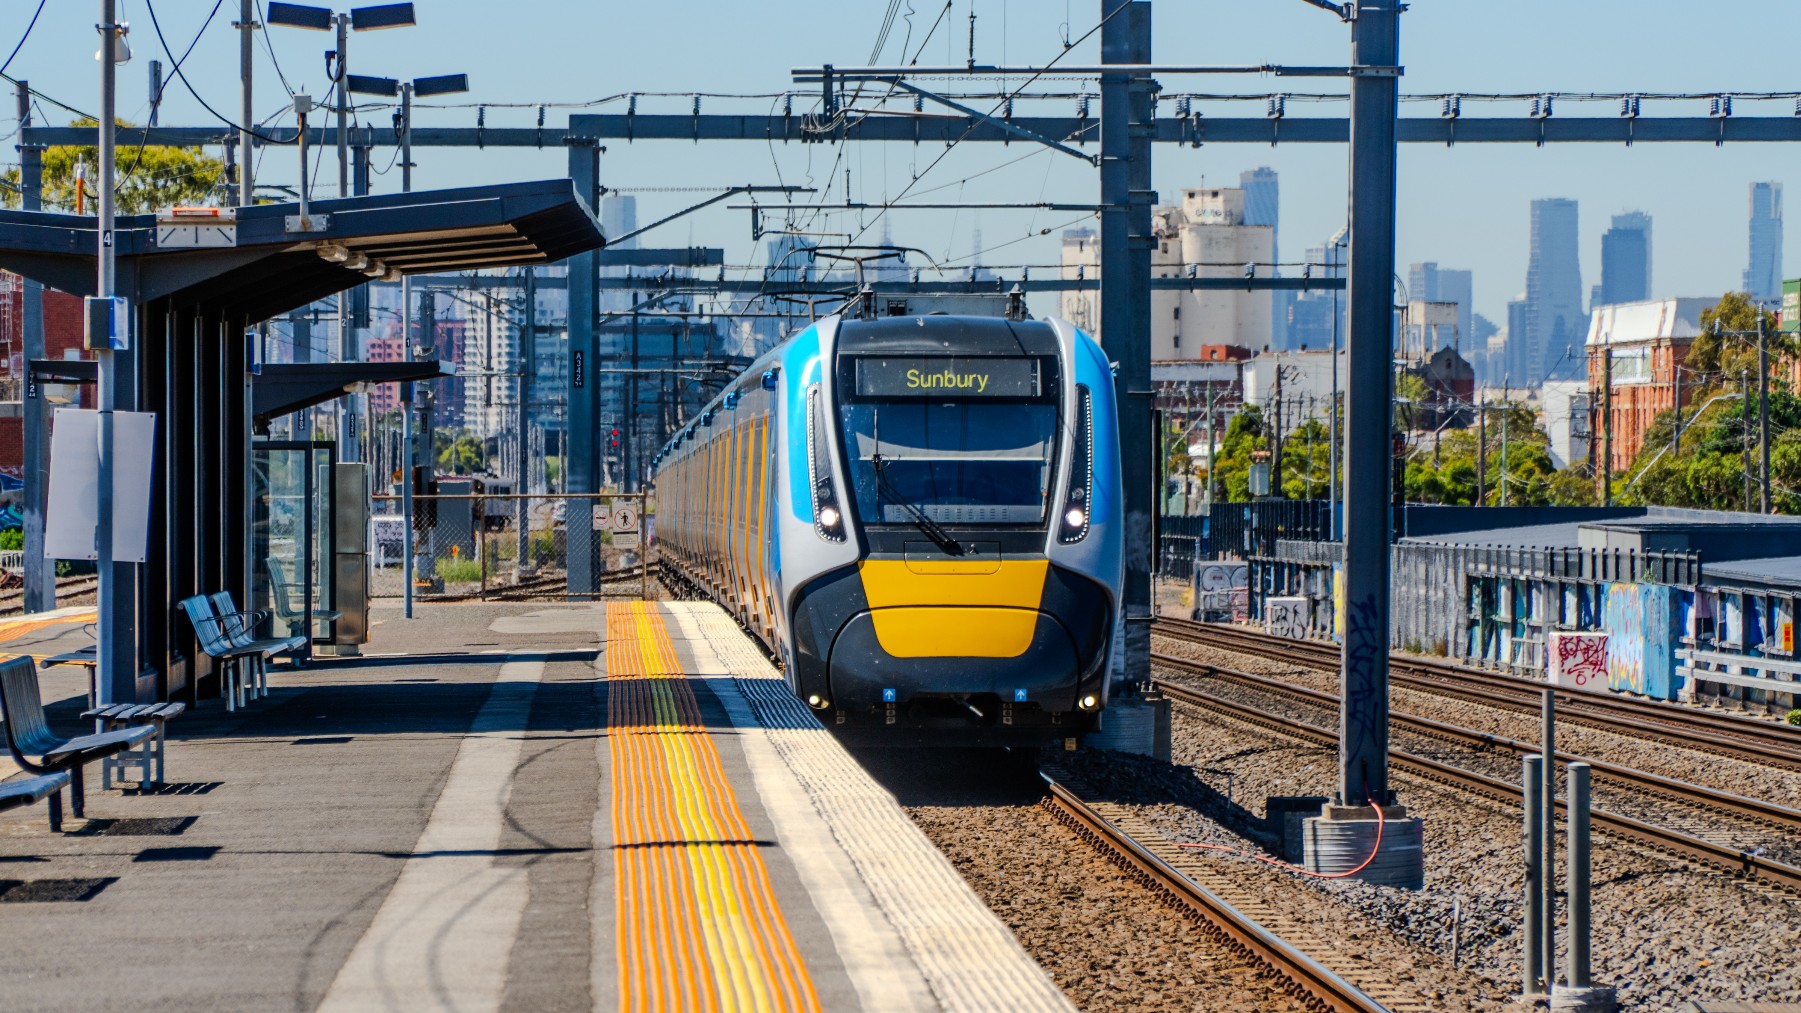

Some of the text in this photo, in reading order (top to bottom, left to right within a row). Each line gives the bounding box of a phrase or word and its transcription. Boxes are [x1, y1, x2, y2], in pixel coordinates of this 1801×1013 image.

[103, 231, 112, 246] 4
[341, 318, 347, 327] 2
[906, 368, 989, 393] Sunbury
